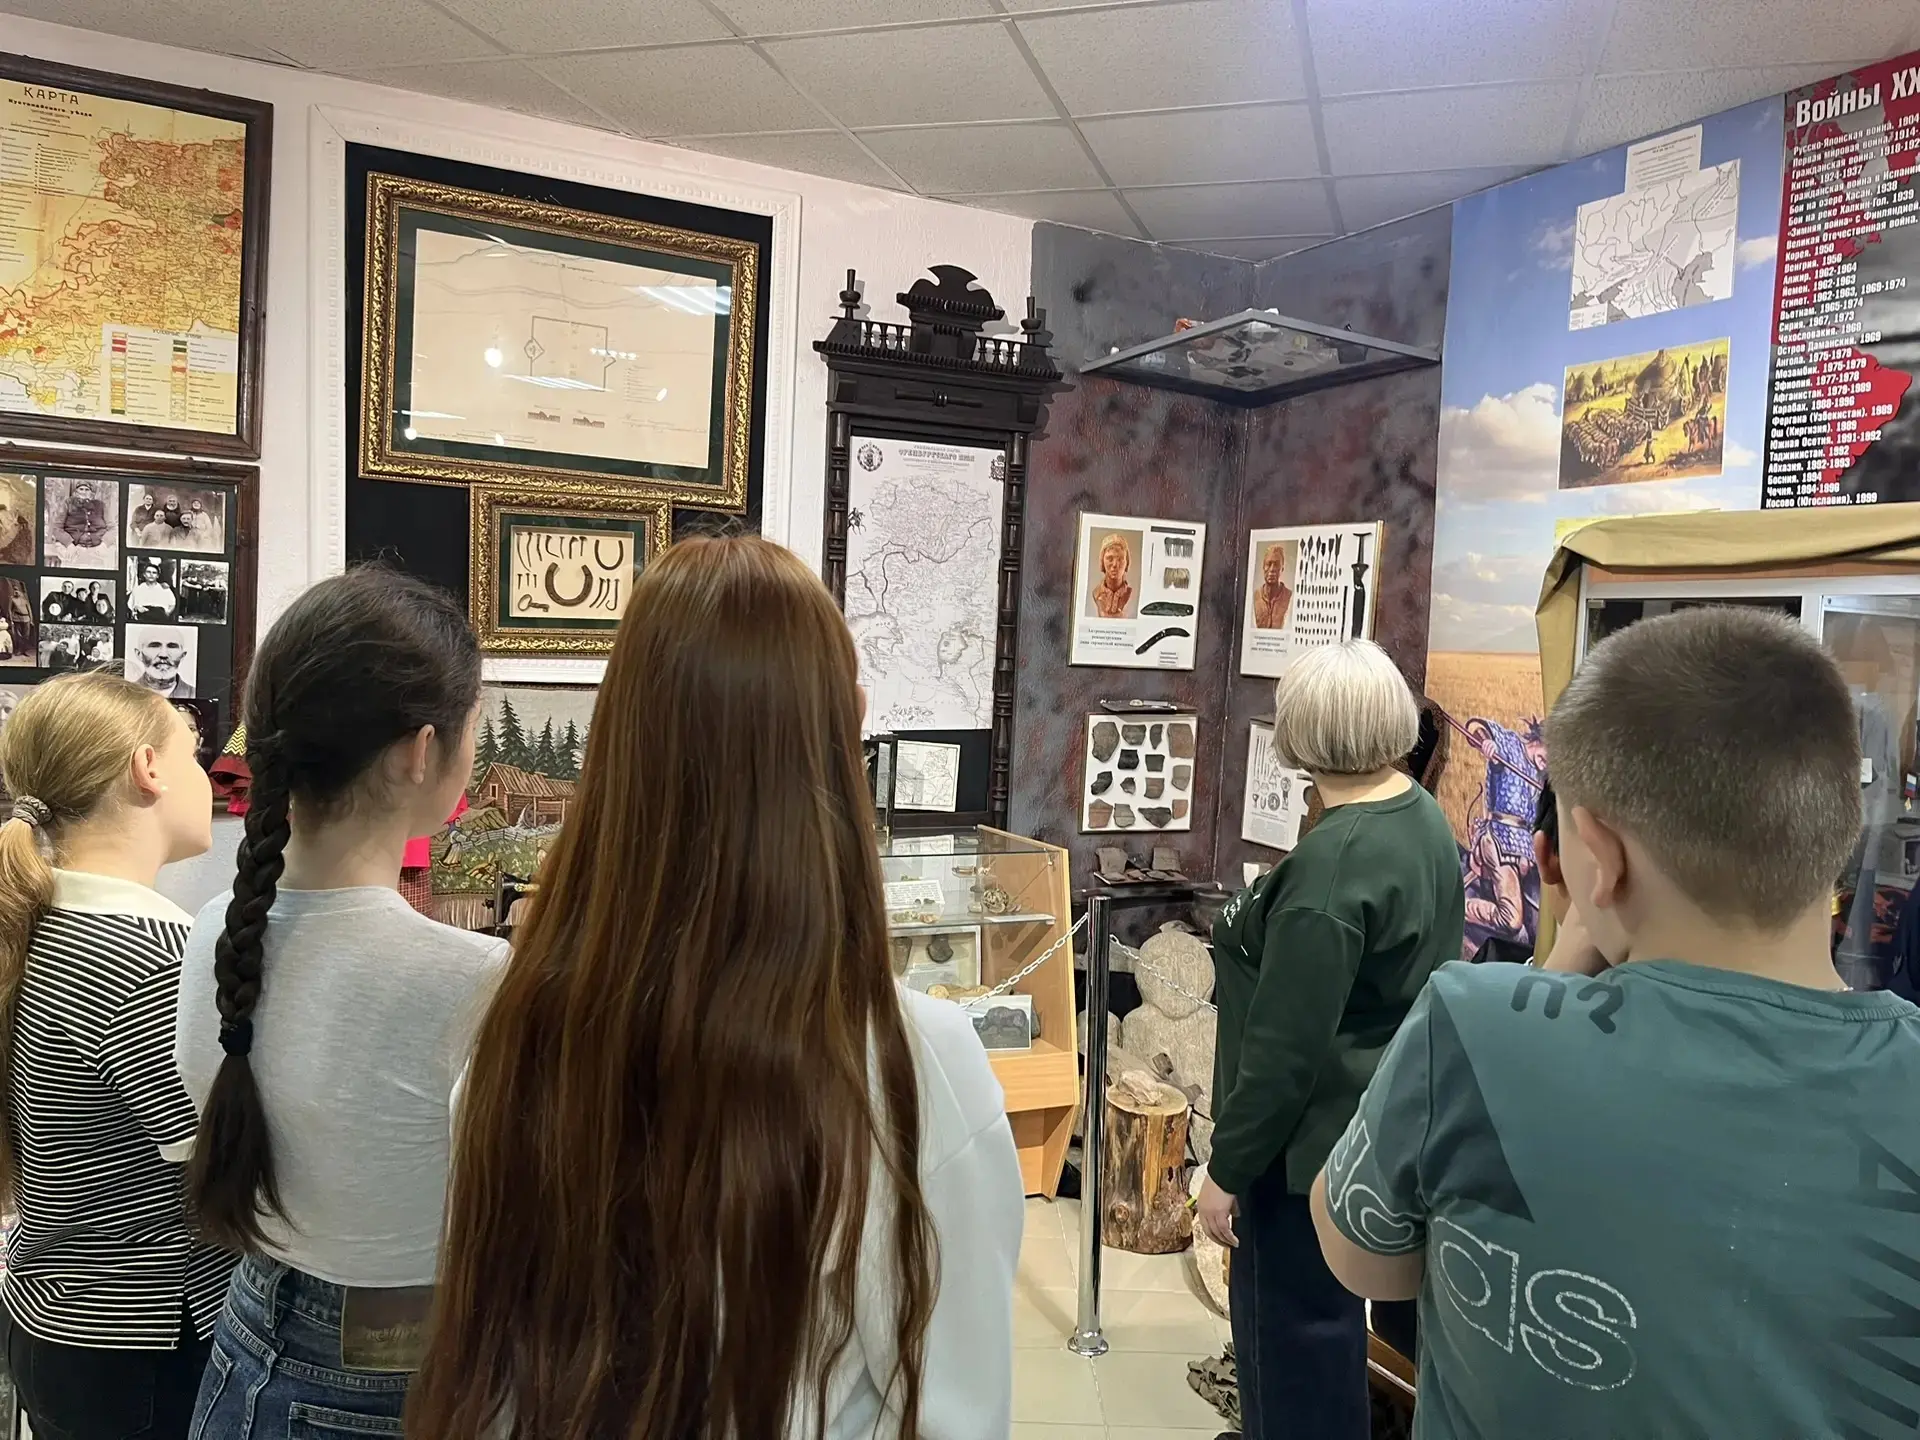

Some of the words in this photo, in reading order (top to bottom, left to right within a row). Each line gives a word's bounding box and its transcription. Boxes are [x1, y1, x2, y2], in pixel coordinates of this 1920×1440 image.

[23, 86, 79, 105] КАРТА
[1796, 83, 1880, 128] Войны
[1792, 152, 1822, 168] Первая
[1824, 142, 1860, 161] мировая
[1792, 160, 1846, 180] Гражданская
[1791, 177, 1817, 192] Китай.
[1820, 165, 1863, 184] 1924-1937
[1790, 183, 1844, 203] Гражданская
[1846, 176, 1872, 190] война
[1789, 202, 1804, 215] Бои
[1806, 202, 1816, 211] на
[1845, 189, 1873, 202] Хасан.
[1876, 180, 1898, 195] 1938
[1788, 214, 1803, 226] Бои
[1805, 213, 1816, 223] на
[1892, 188, 1914, 203] 1939
[1855, 214, 1861, 223] с
[1786, 235, 1820, 250] Великая
[1822, 222, 1886, 242] Отечественная
[1785, 250, 1811, 262] Корея.
[1814, 243, 1835, 256] 1950
[1784, 261, 1819, 273] Венгрия.
[1782, 272, 1811, 285] Алжир.
[1779, 307, 1817, 320] Вьетнам.
[1820, 297, 1864, 313] 1965-1974
[1781, 296, 1809, 309] Египет.
[1779, 320, 1806, 332] Сирия.
[1834, 311, 1855, 323] 1973
[1778, 327, 1838, 344] Чехословакия.
[1777, 344, 1806, 356] Остров
[1775, 356, 1806, 368] Ангола.
[1775, 365, 1820, 379] Мозамбик.
[1774, 380, 1813, 392] Эфиопия.
[1773, 389, 1824, 403] Афганистан.
[1772, 402, 1809, 415] Карабах.
[1771, 415, 1807, 427] Фергана
[1809, 407, 1868, 423] (Узбекистан).
[1771, 428, 1784, 438] Ош
[1785, 423, 1833, 437] (Киргизия).
[1770, 440, 1800, 450] Южная
[1801, 435, 1834, 447] Осетия.
[1769, 448, 1826, 462] Таджикистан.
[1768, 462, 1804, 474] Абхазия.
[1767, 474, 1799, 485] Босния.
[1801, 471, 1822, 483] 1994
[1767, 486, 1794, 497] Чечня.
[1765, 498, 1795, 508] Косово
[1796, 494, 1853, 508] (Югославия).
[1855, 492, 1878, 504] 1999
